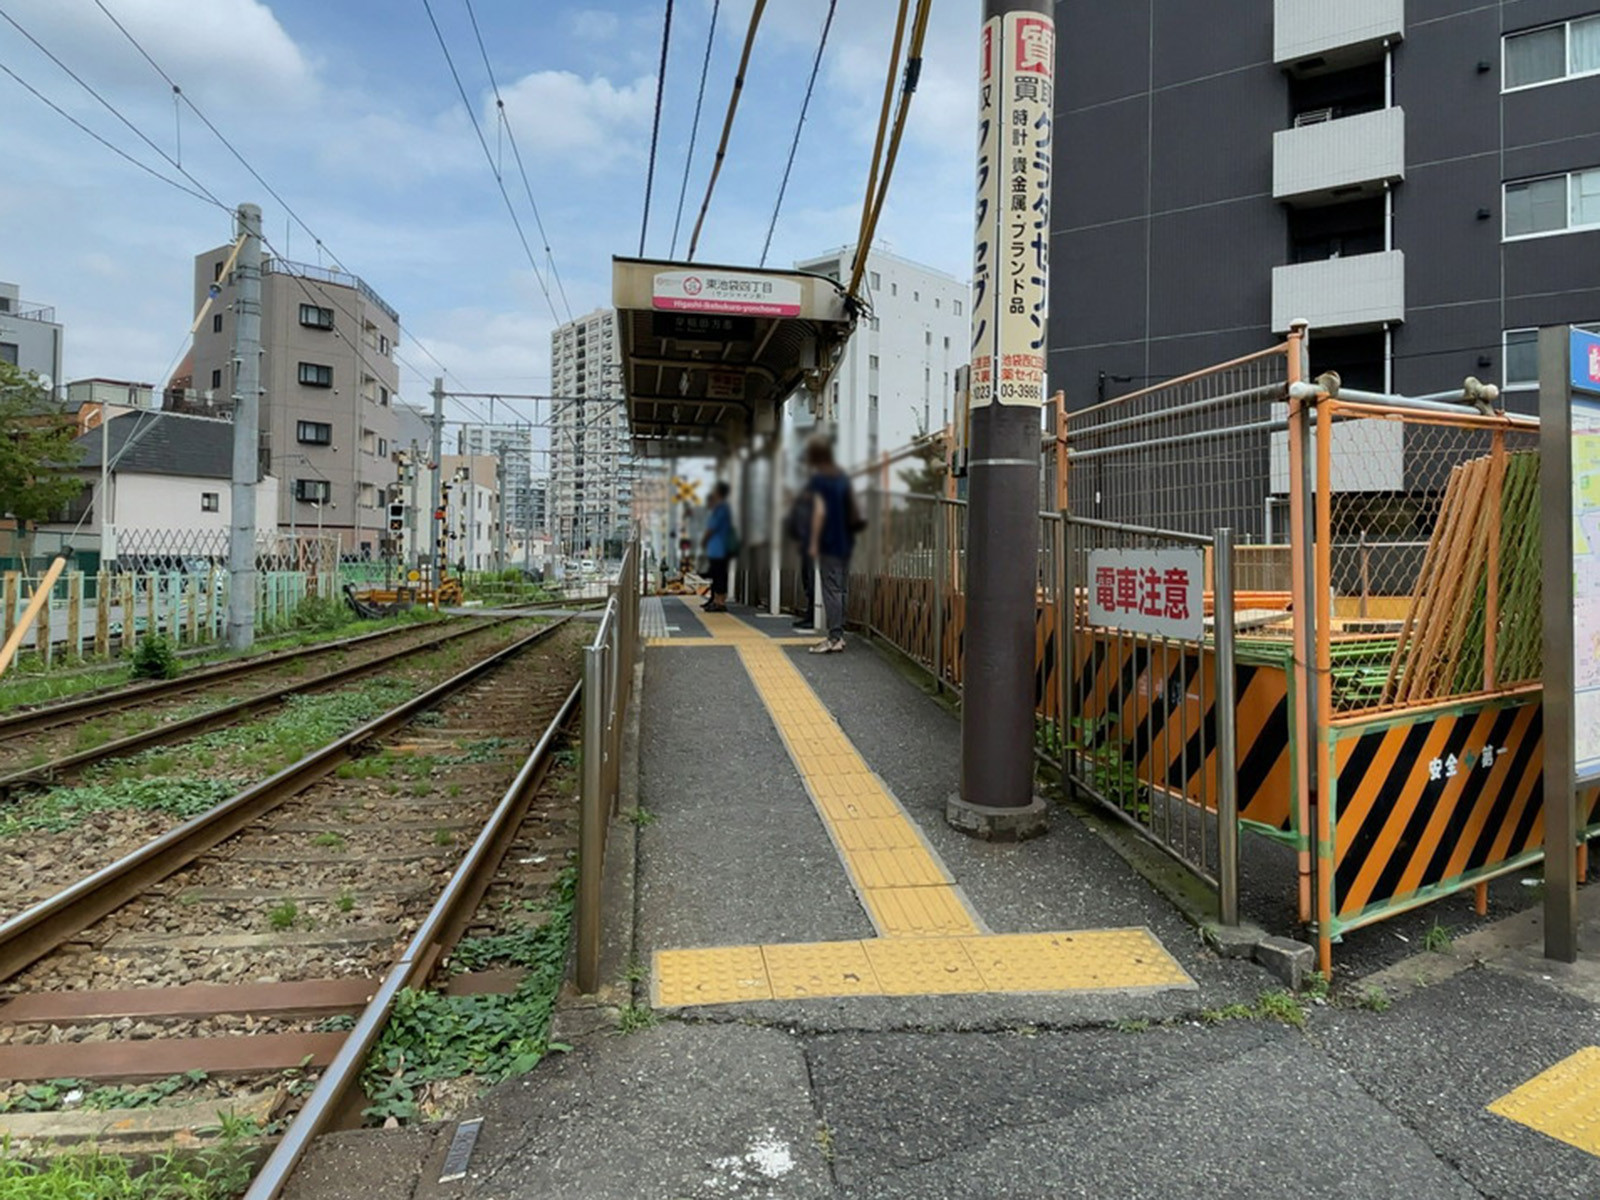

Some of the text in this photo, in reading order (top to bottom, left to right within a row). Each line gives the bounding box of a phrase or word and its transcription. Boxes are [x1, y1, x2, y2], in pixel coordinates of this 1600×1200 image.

[1010, 109, 1028, 314] 時計・貴金属・ブランド品
[705, 279, 773, 293] 東池袋四丁目
[1096, 567, 1190, 620] 電車注意
